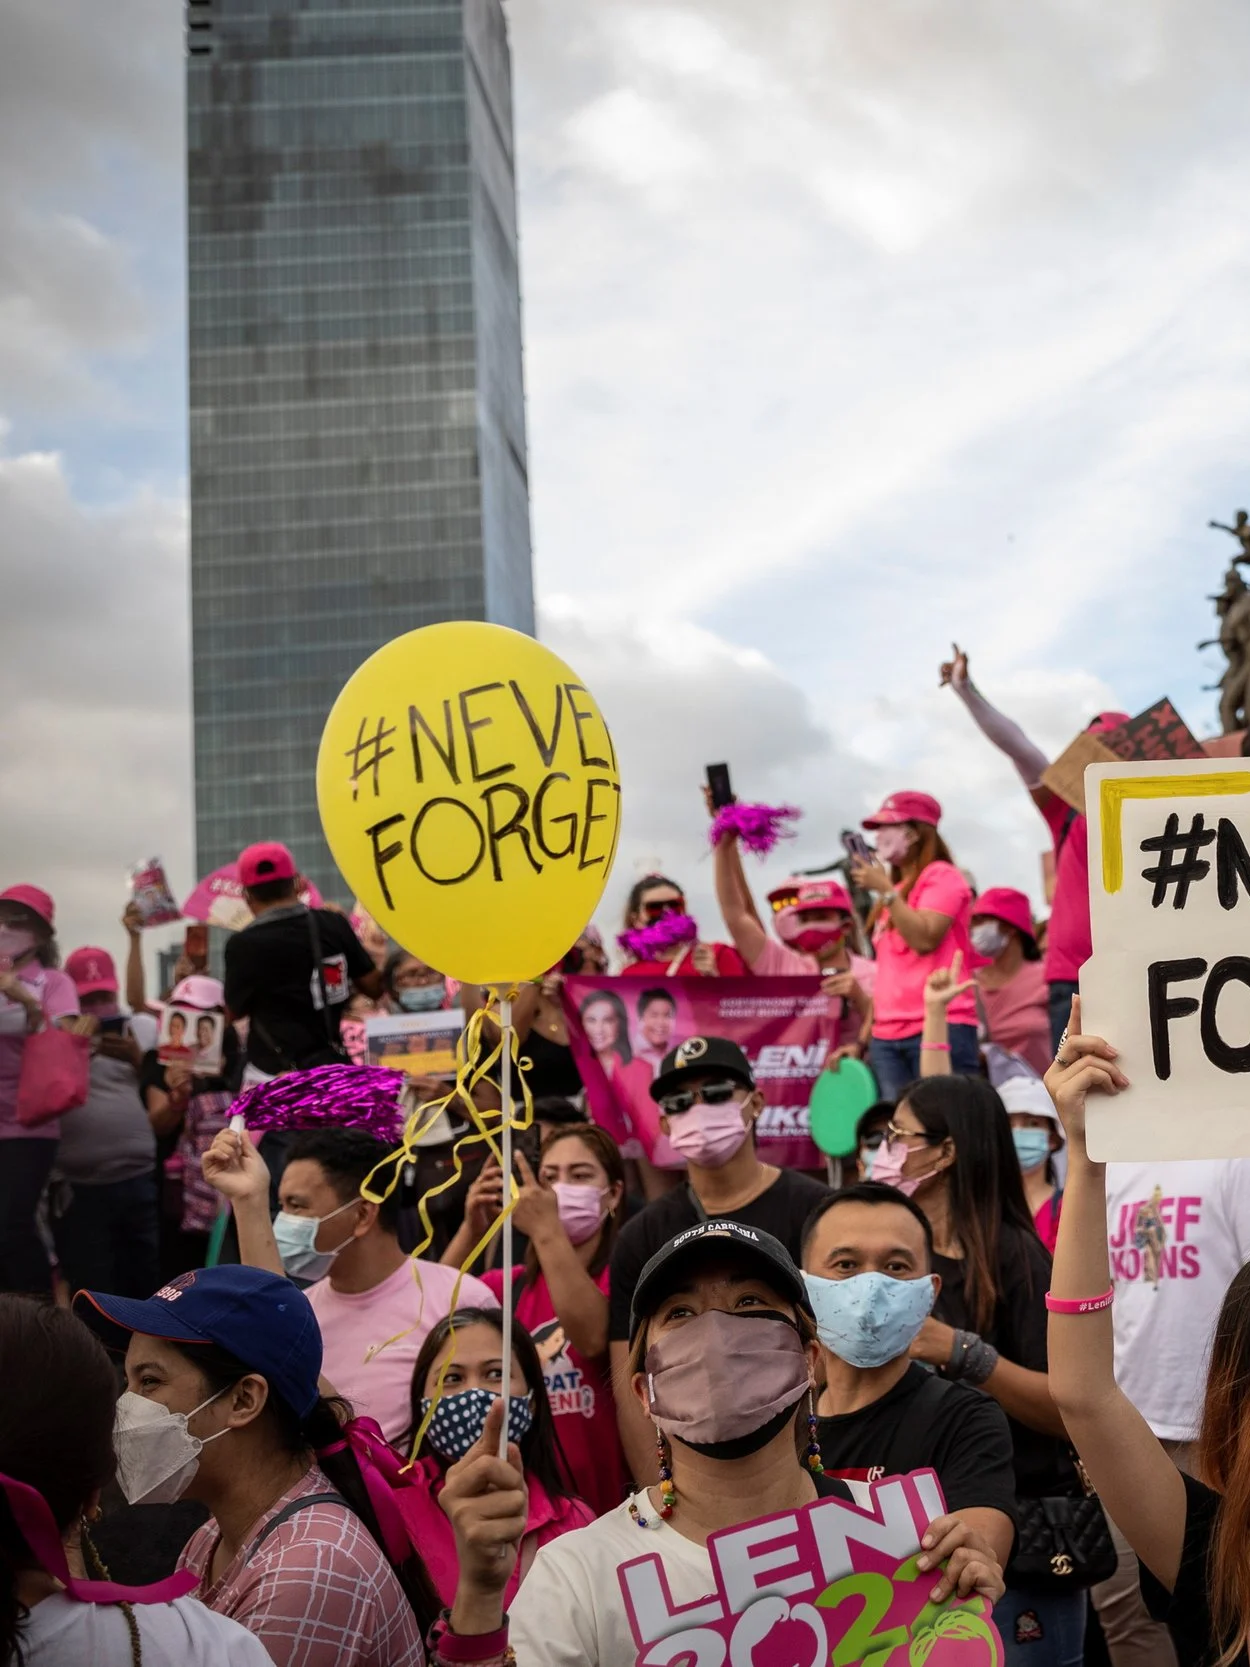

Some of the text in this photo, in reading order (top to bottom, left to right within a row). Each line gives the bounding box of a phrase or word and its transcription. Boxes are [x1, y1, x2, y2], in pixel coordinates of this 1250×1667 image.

[345, 679, 617, 802] #NEVE
[673, 1223, 760, 1248] SOUTH CAROLINA
[1111, 1245, 1200, 1281] KONS
[153, 1286, 183, 1302] 998
[624, 1473, 947, 1644] LENI
